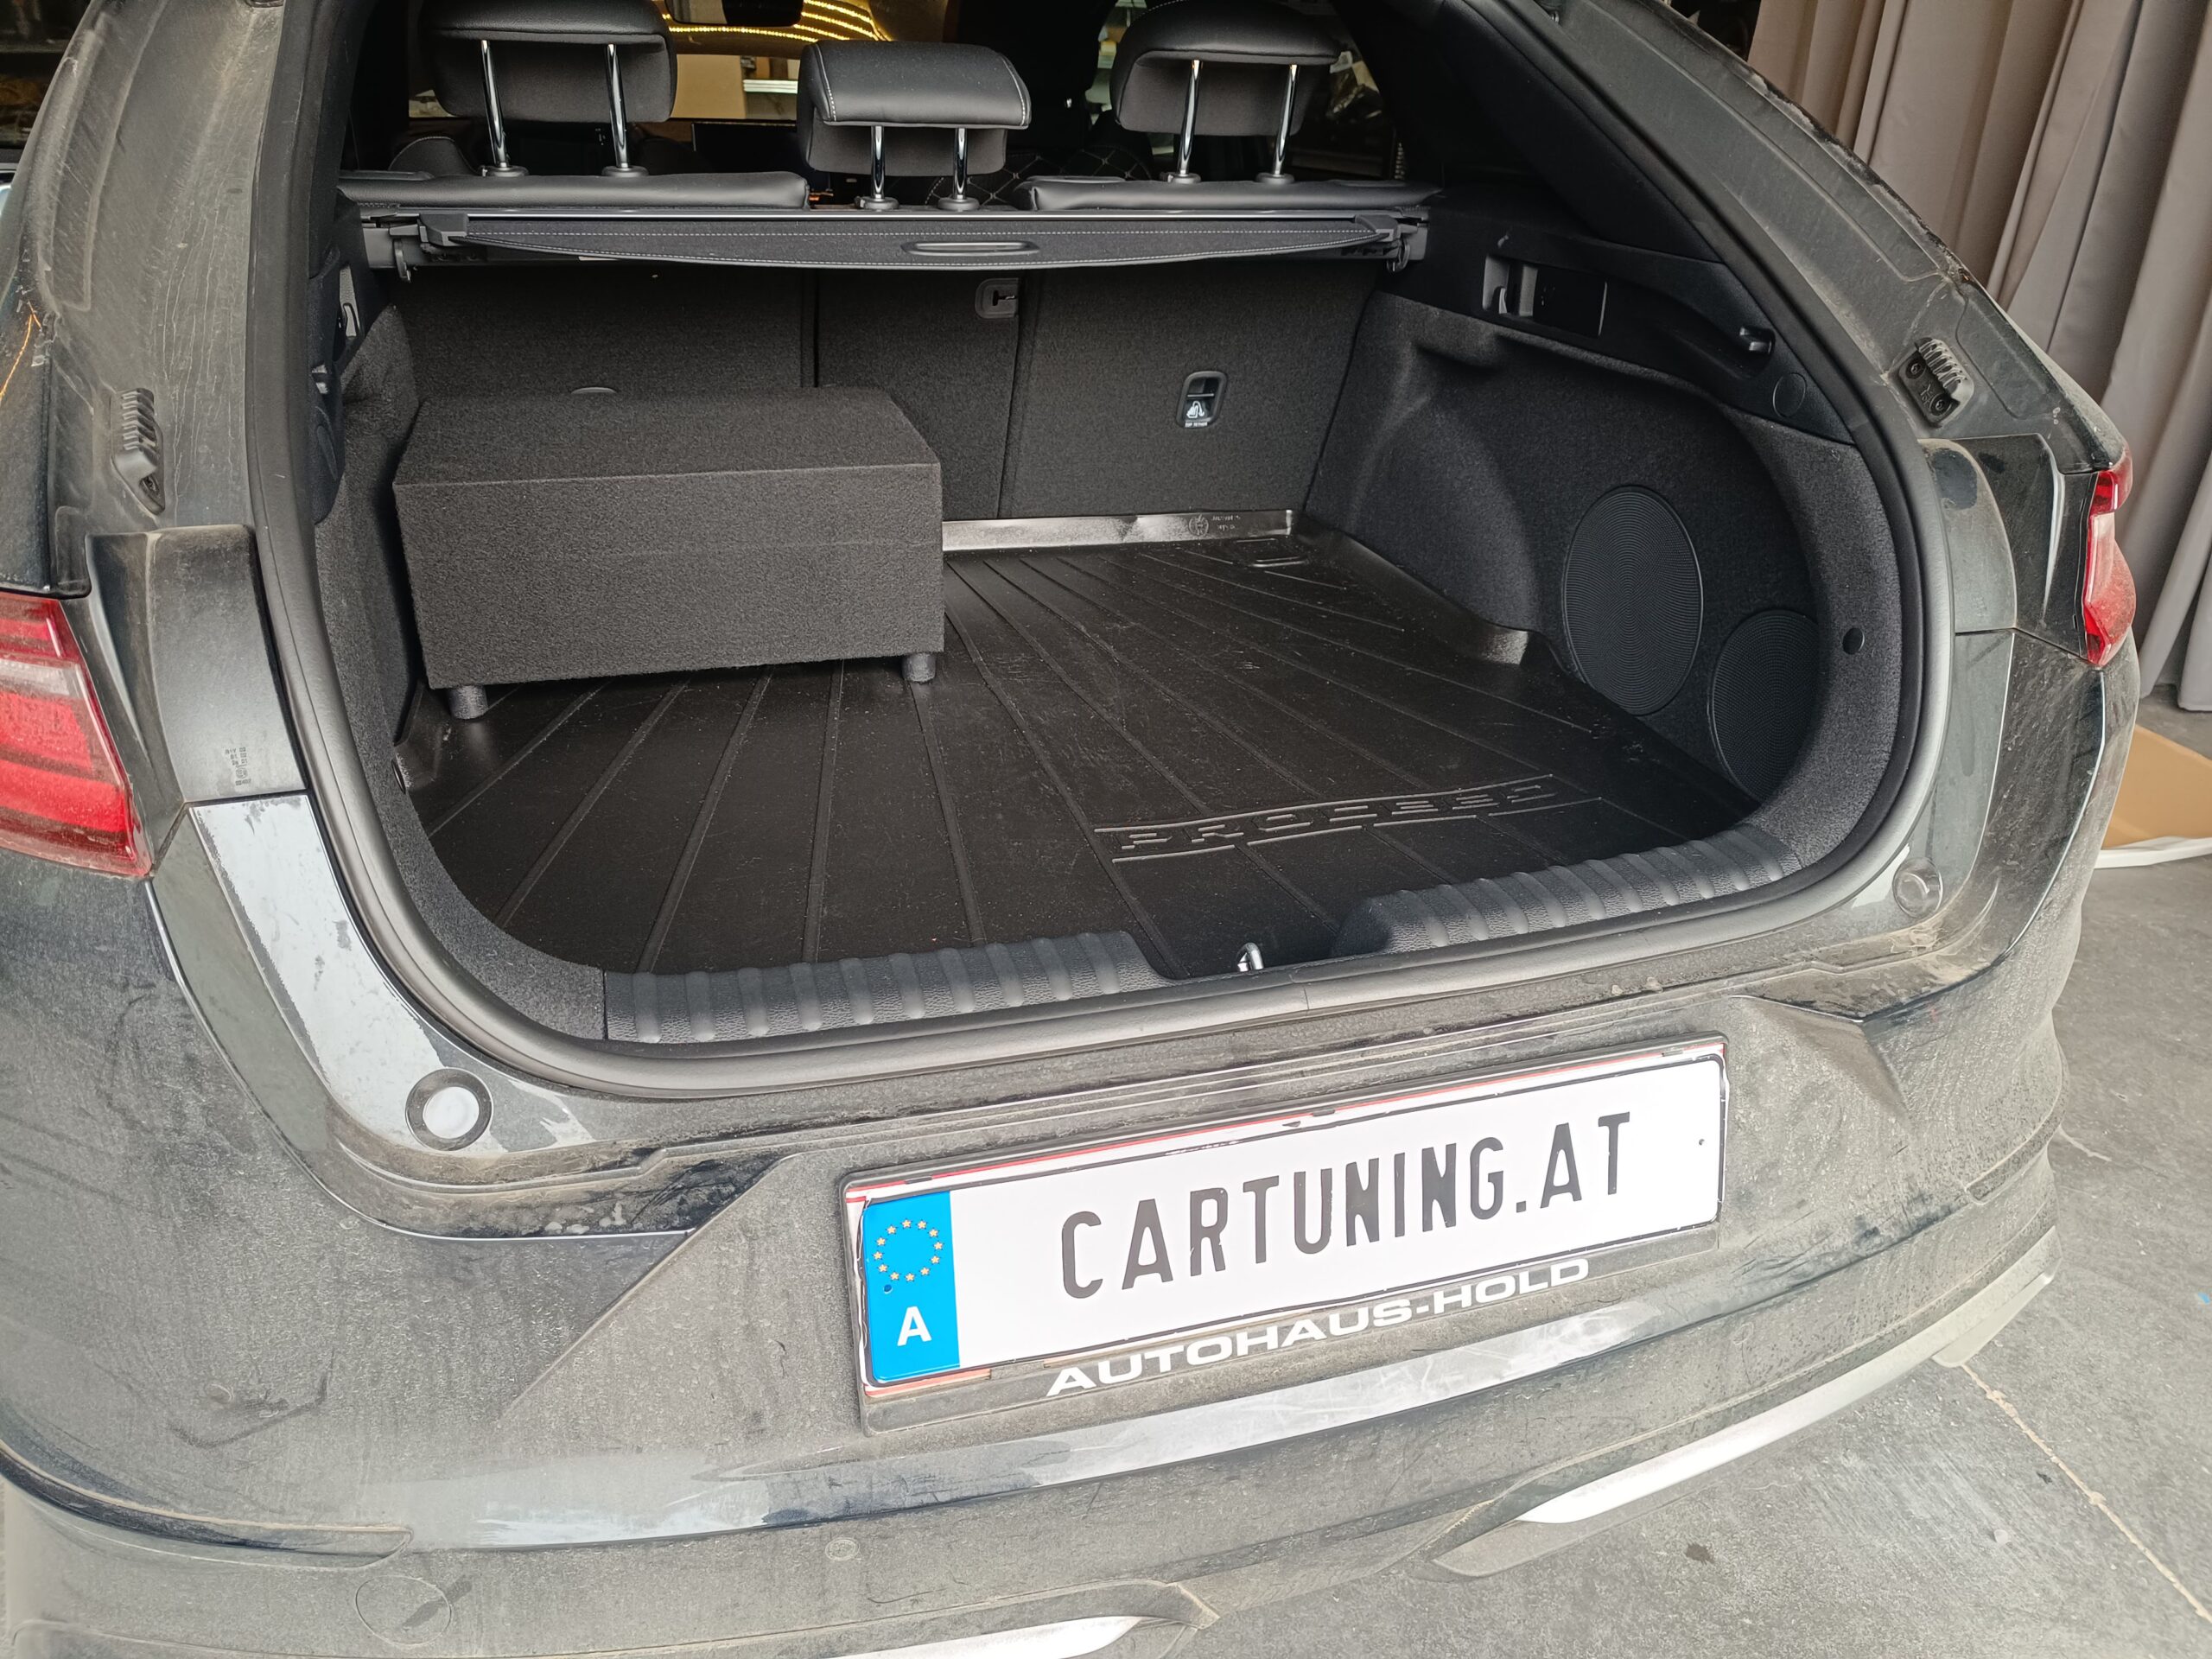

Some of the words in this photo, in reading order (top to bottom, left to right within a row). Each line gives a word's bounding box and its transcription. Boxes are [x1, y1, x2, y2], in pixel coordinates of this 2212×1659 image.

[1062, 1111, 1630, 1299] CARTUNING.AT
[897, 1306, 932, 1346] A
[1046, 1258, 1590, 1397] AUTOHAUS-HOLD
